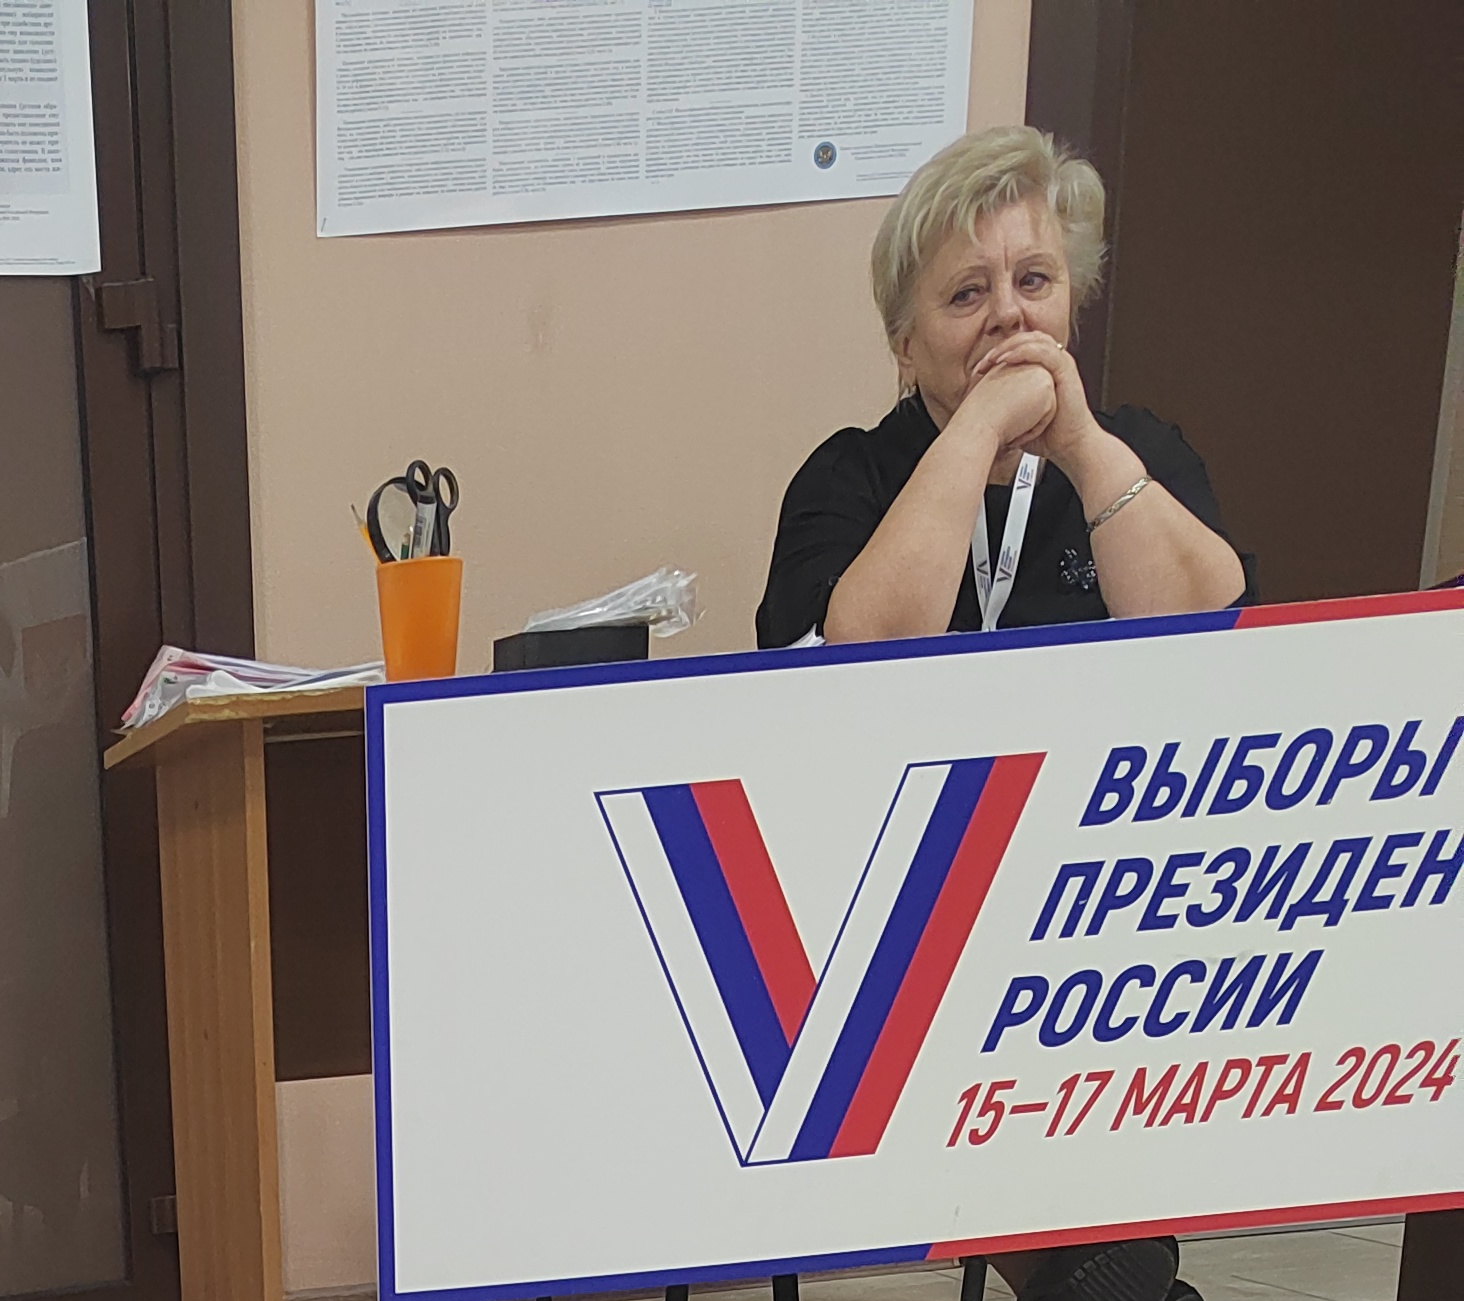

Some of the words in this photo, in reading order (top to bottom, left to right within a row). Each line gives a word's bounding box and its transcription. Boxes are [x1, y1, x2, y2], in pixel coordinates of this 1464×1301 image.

[1079, 715, 1464, 827] ВЫБОРЫ
[1029, 829, 1464, 941] ПРЕЗИДЕН
[980, 949, 1325, 1053] РОССИИ
[1109, 1051, 1312, 1132] МАРТА
[1313, 1037, 1462, 1112] 2024
